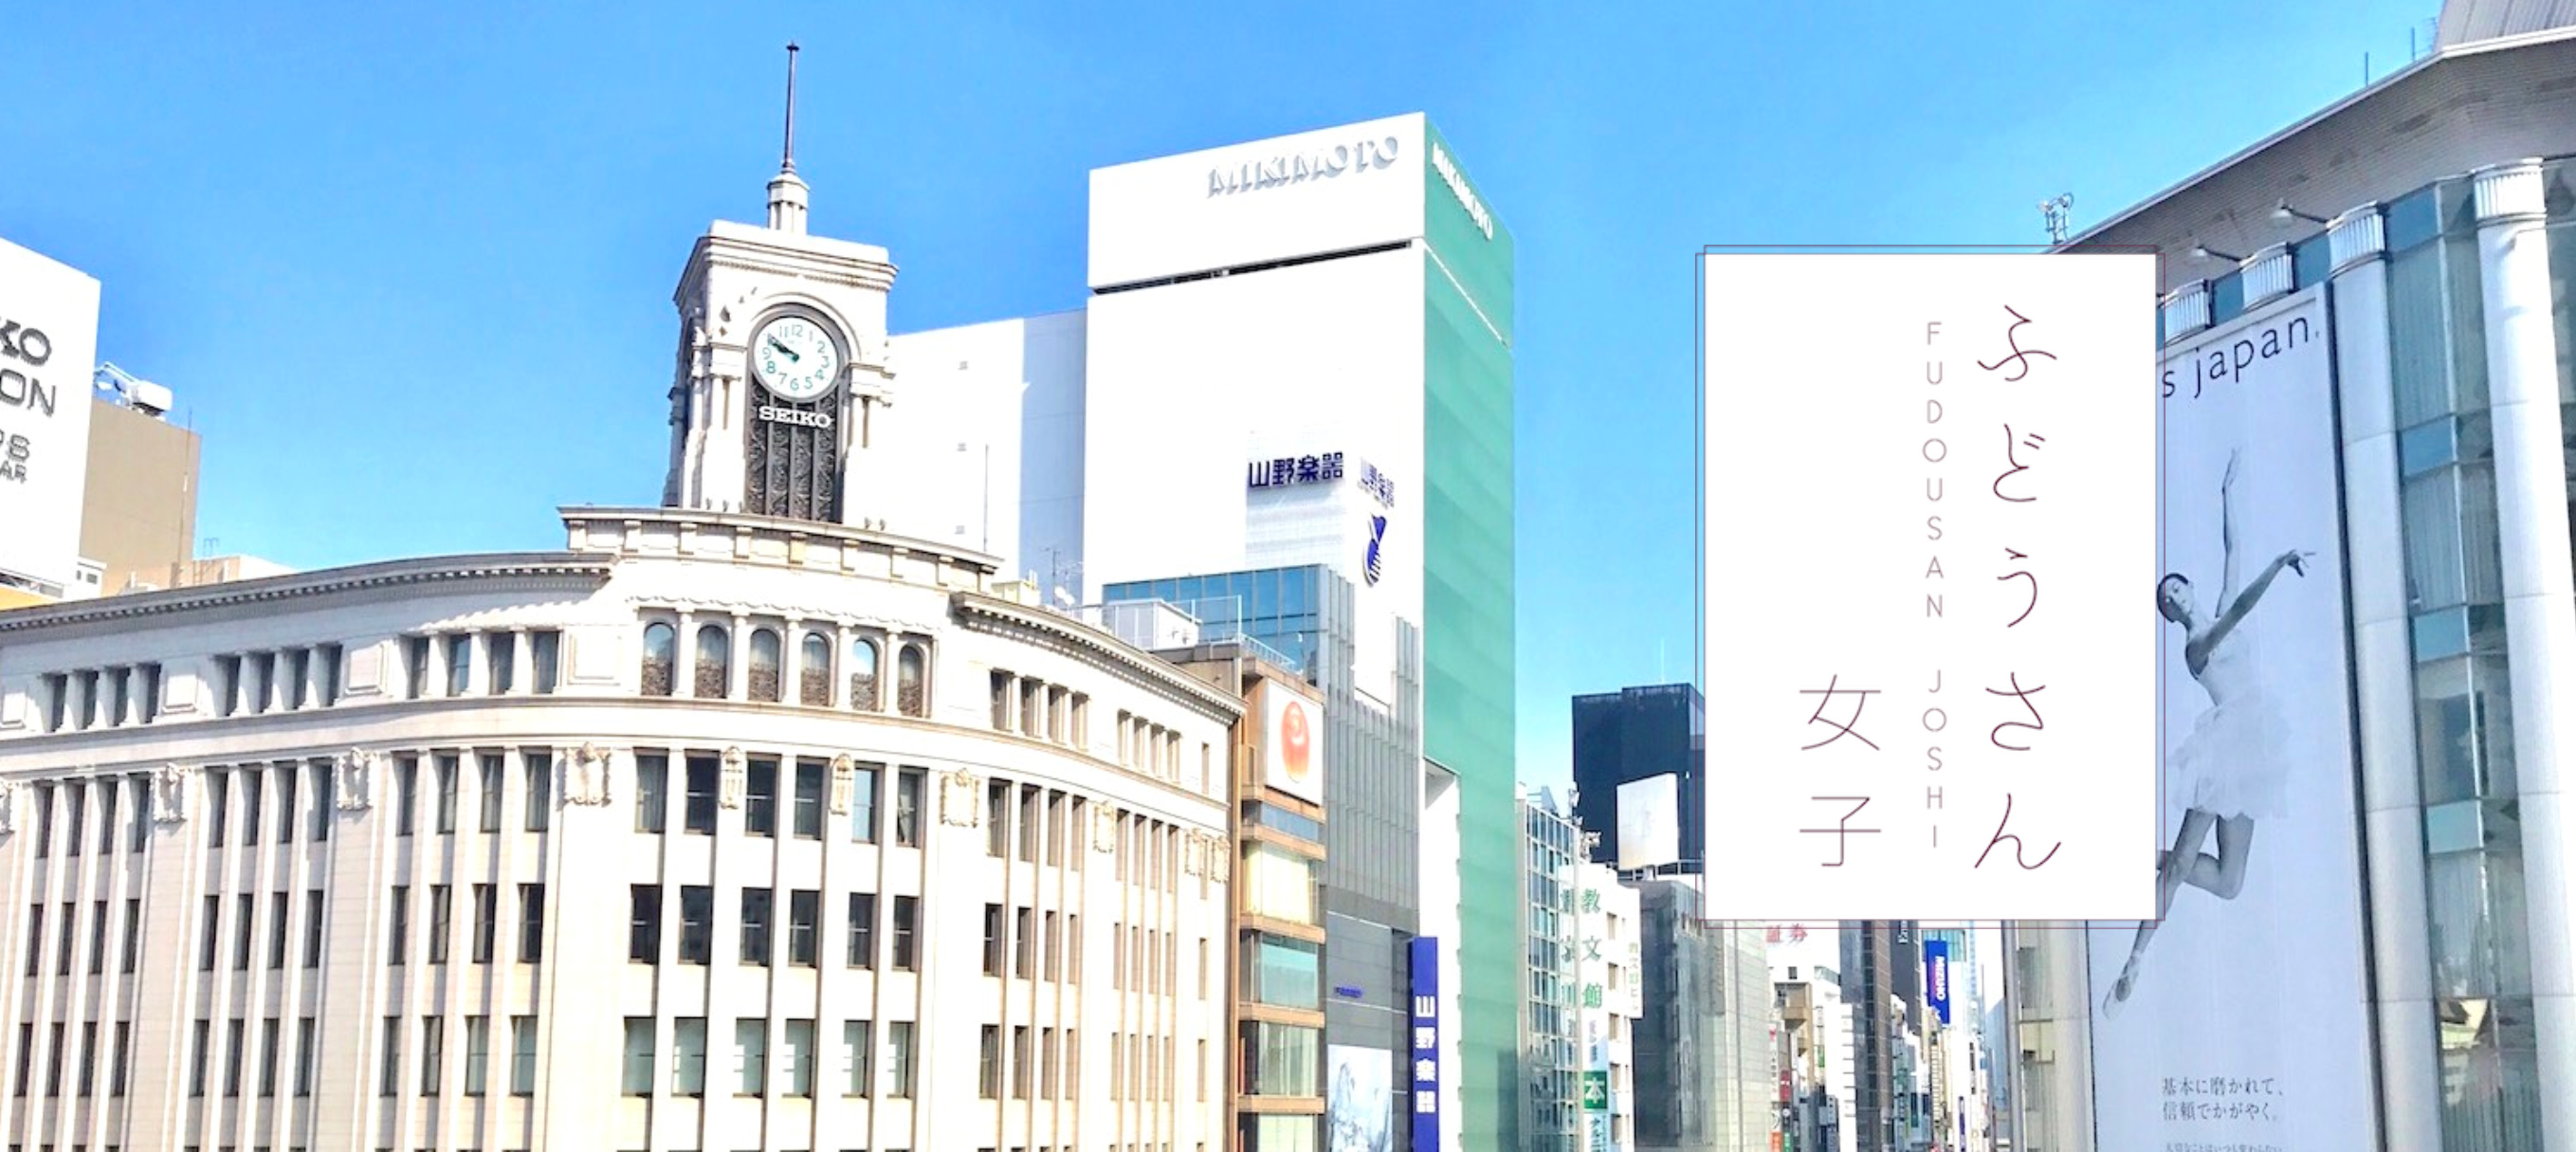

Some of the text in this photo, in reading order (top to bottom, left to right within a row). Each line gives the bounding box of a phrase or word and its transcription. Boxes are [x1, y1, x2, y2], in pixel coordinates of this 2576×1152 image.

[1207, 137, 1398, 197] MIKIMOTO
[779, 325, 789, 338] 11
[791, 323, 803, 338] 12
[809, 329, 814, 342] 1
[762, 346, 772, 360] 9
[817, 339, 826, 354] 2
[766, 360, 776, 375] 8
[821, 355, 830, 369] 3
[778, 371, 788, 385] 7
[790, 377, 800, 392] 6
[804, 376, 813, 390] 5
[758, 406, 832, 429] SEIKO
[1248, 451, 1343, 488] 山野楽器
[1581, 887, 1604, 1010] 教文館
[1416, 996, 1436, 1113] 山野楽器
[1585, 1076, 1606, 1105] 本
[2163, 1076, 2283, 1096] 基本に磨かれて、
[2163, 1102, 2277, 1122] 信頼でかがやく。
